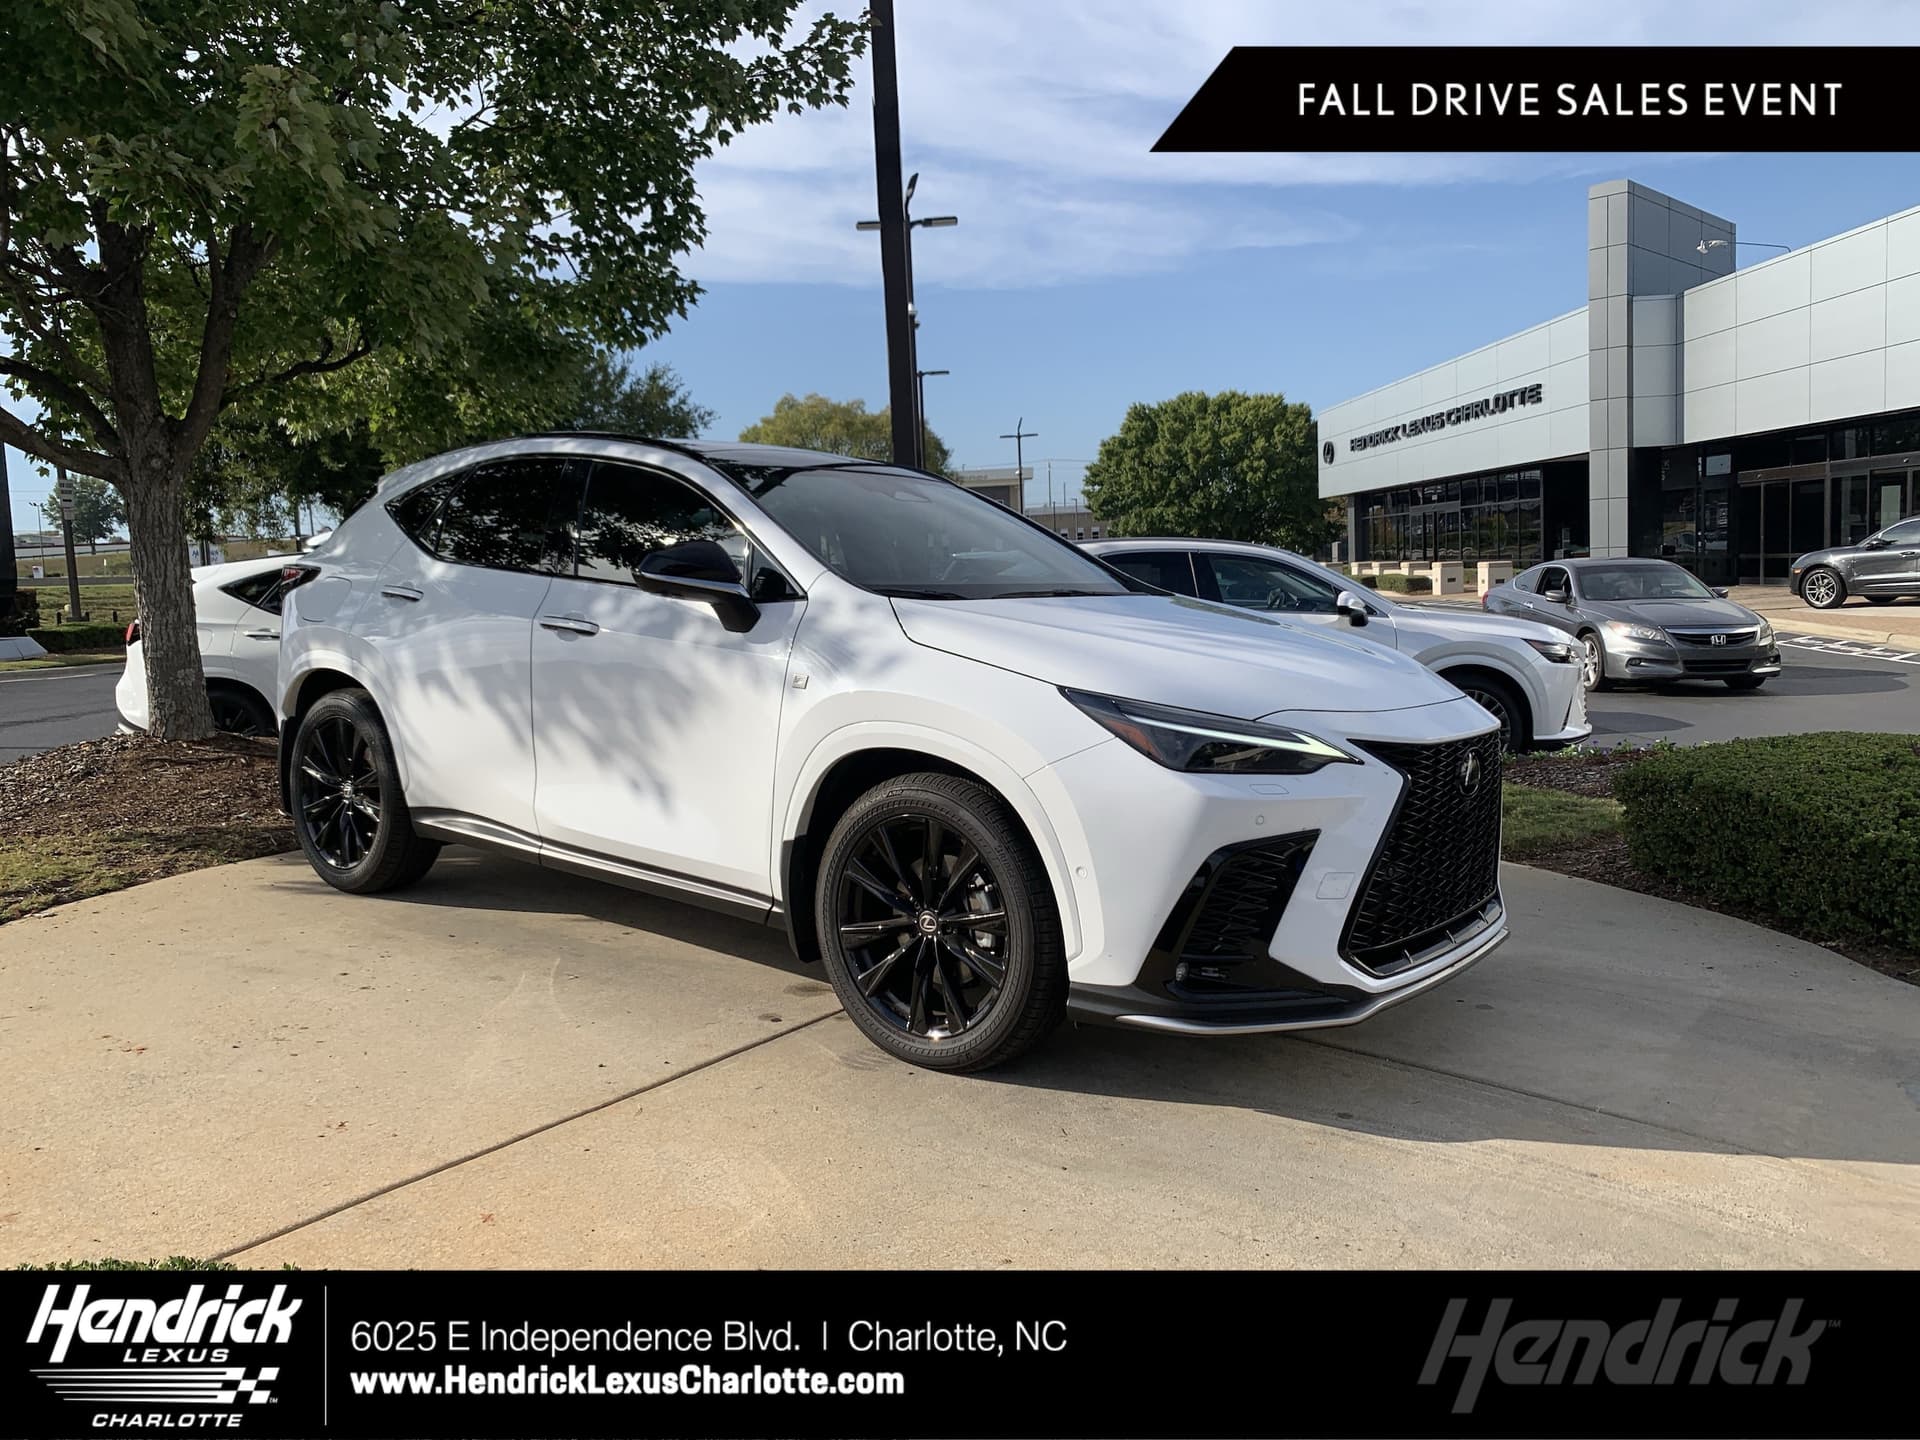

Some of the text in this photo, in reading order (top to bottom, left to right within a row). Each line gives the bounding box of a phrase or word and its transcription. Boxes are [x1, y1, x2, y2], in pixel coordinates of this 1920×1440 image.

[1350, 383, 1543, 452] HENDRICK LEXUS CHARLOTTE
